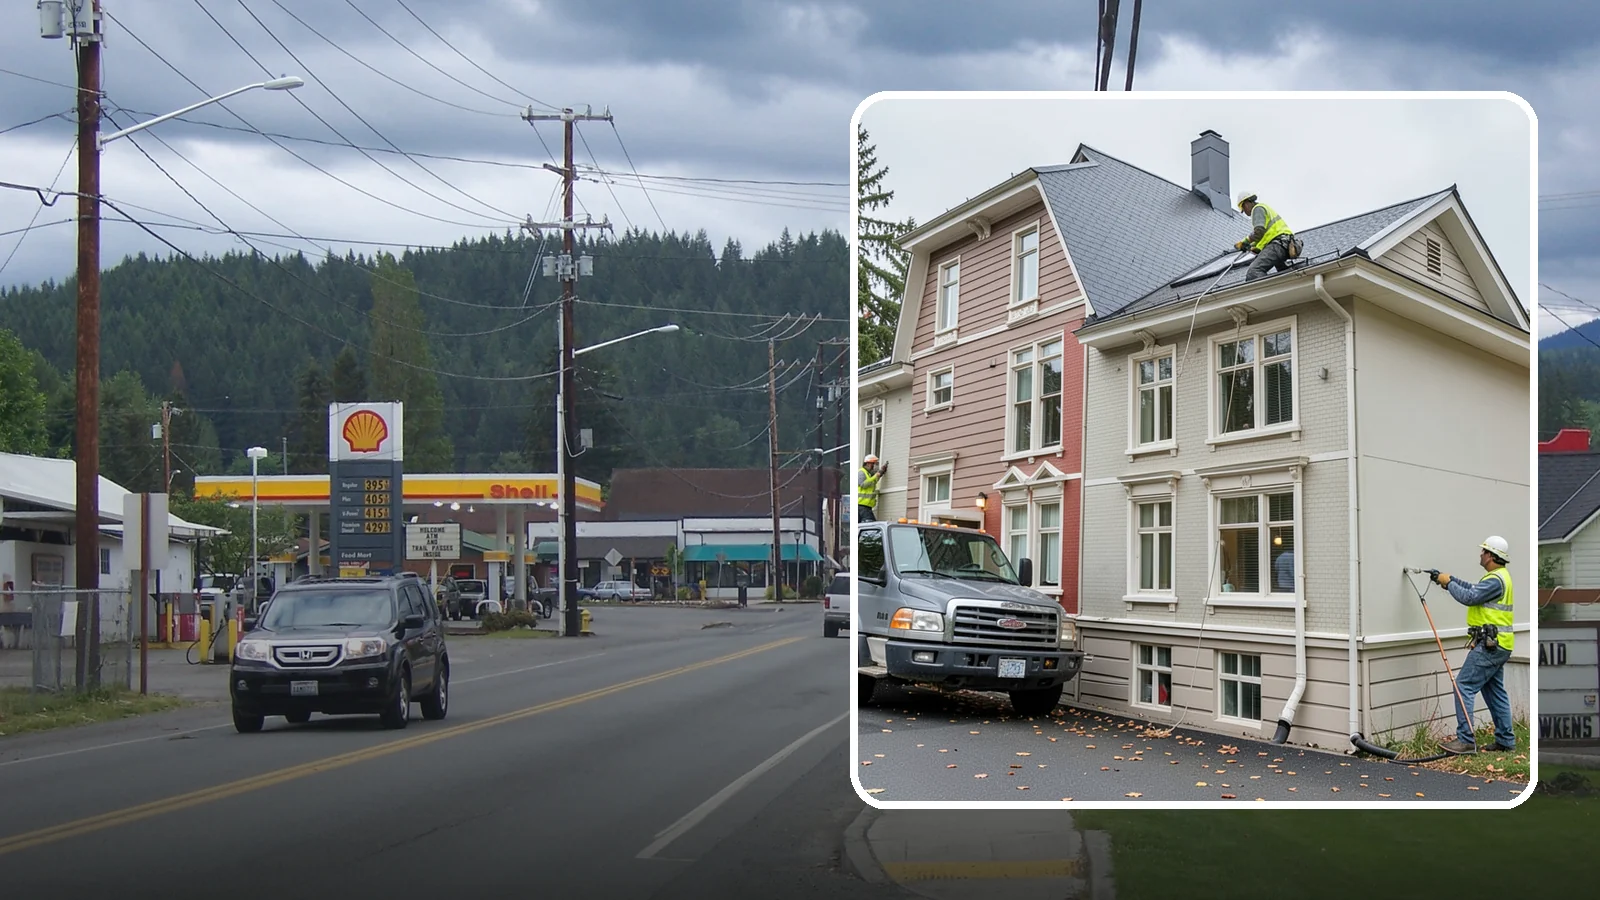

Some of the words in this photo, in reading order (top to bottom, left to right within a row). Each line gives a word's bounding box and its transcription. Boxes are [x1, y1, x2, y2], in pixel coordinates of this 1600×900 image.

[490, 484, 547, 499] Shell
[1538, 642, 1567, 666] AID
[1538, 716, 1592, 739] WKENS
